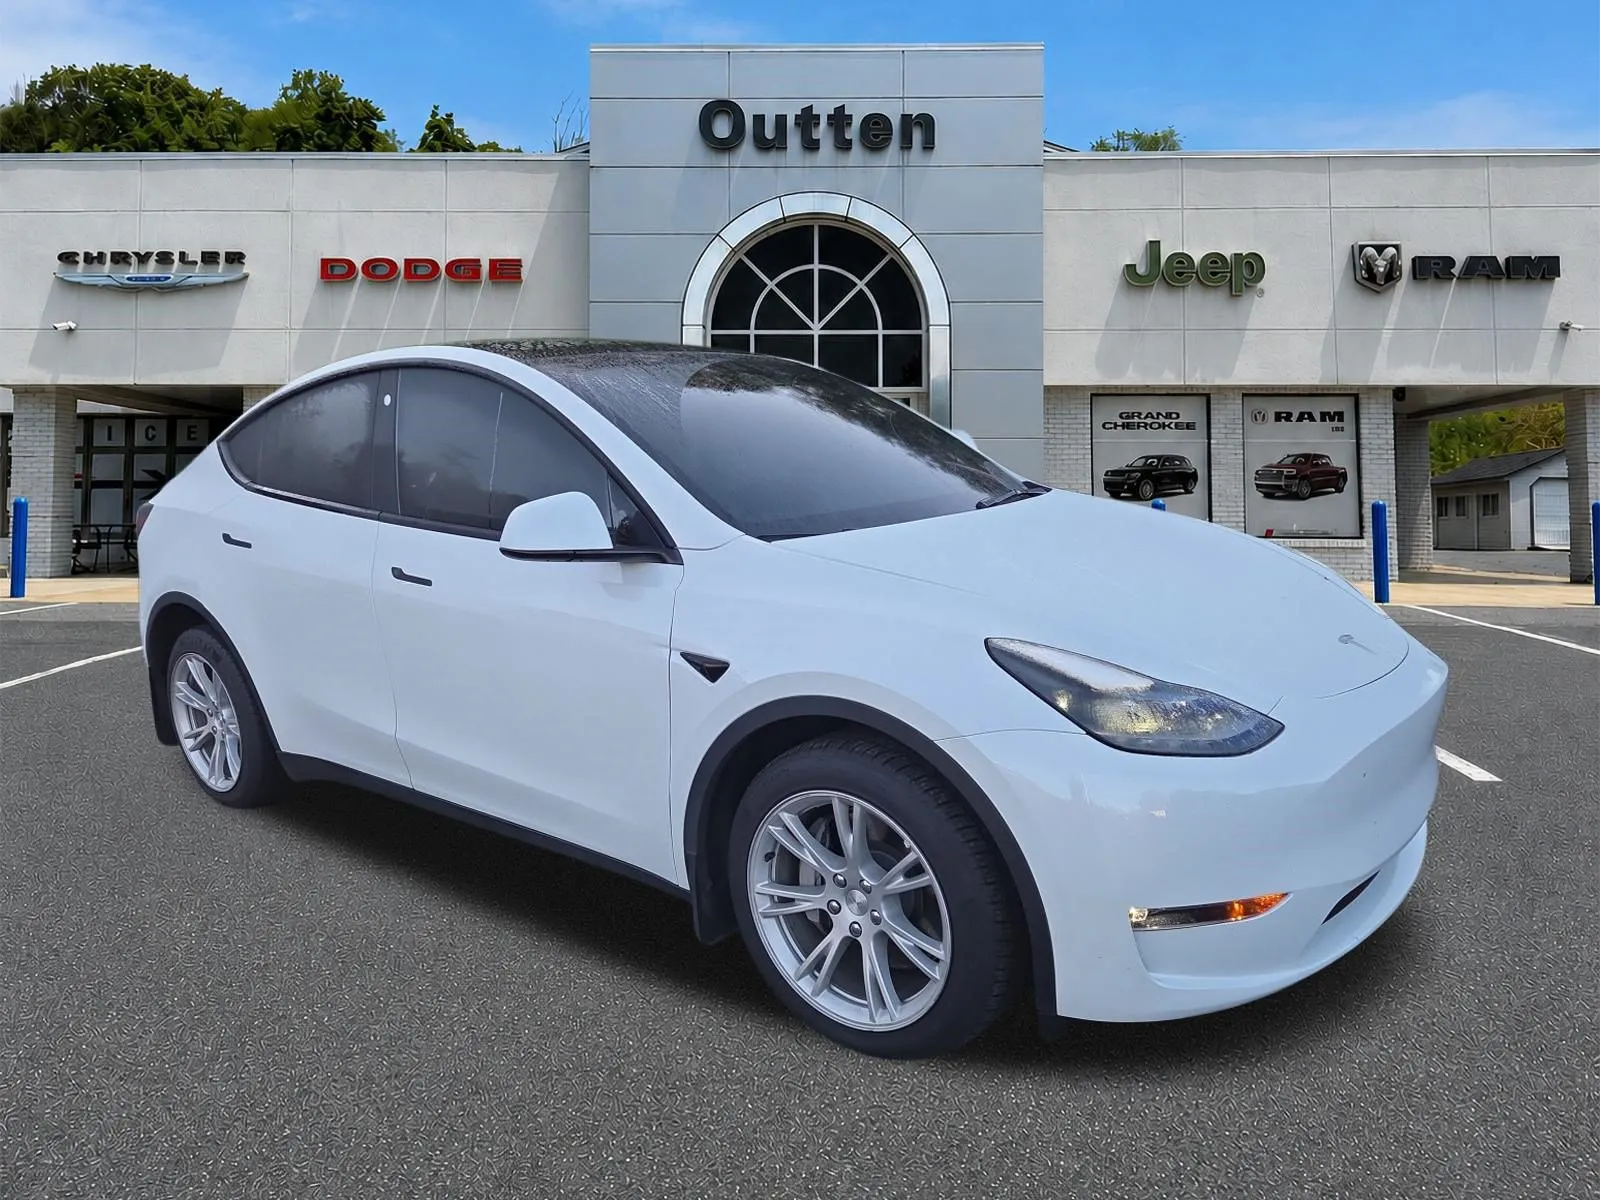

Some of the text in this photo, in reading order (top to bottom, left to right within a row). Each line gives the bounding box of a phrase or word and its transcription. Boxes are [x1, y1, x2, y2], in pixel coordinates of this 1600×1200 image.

[699, 99, 936, 150] Outten
[57, 250, 248, 266] CHRYSLER
[1123, 239, 1266, 296] Jeep
[1411, 255, 1561, 280] RAM
[320, 257, 523, 282] DODGE
[1101, 421, 1197, 431] CHEROKEE
[1118, 411, 1181, 421] GRAND
[1274, 411, 1345, 423] RAM
